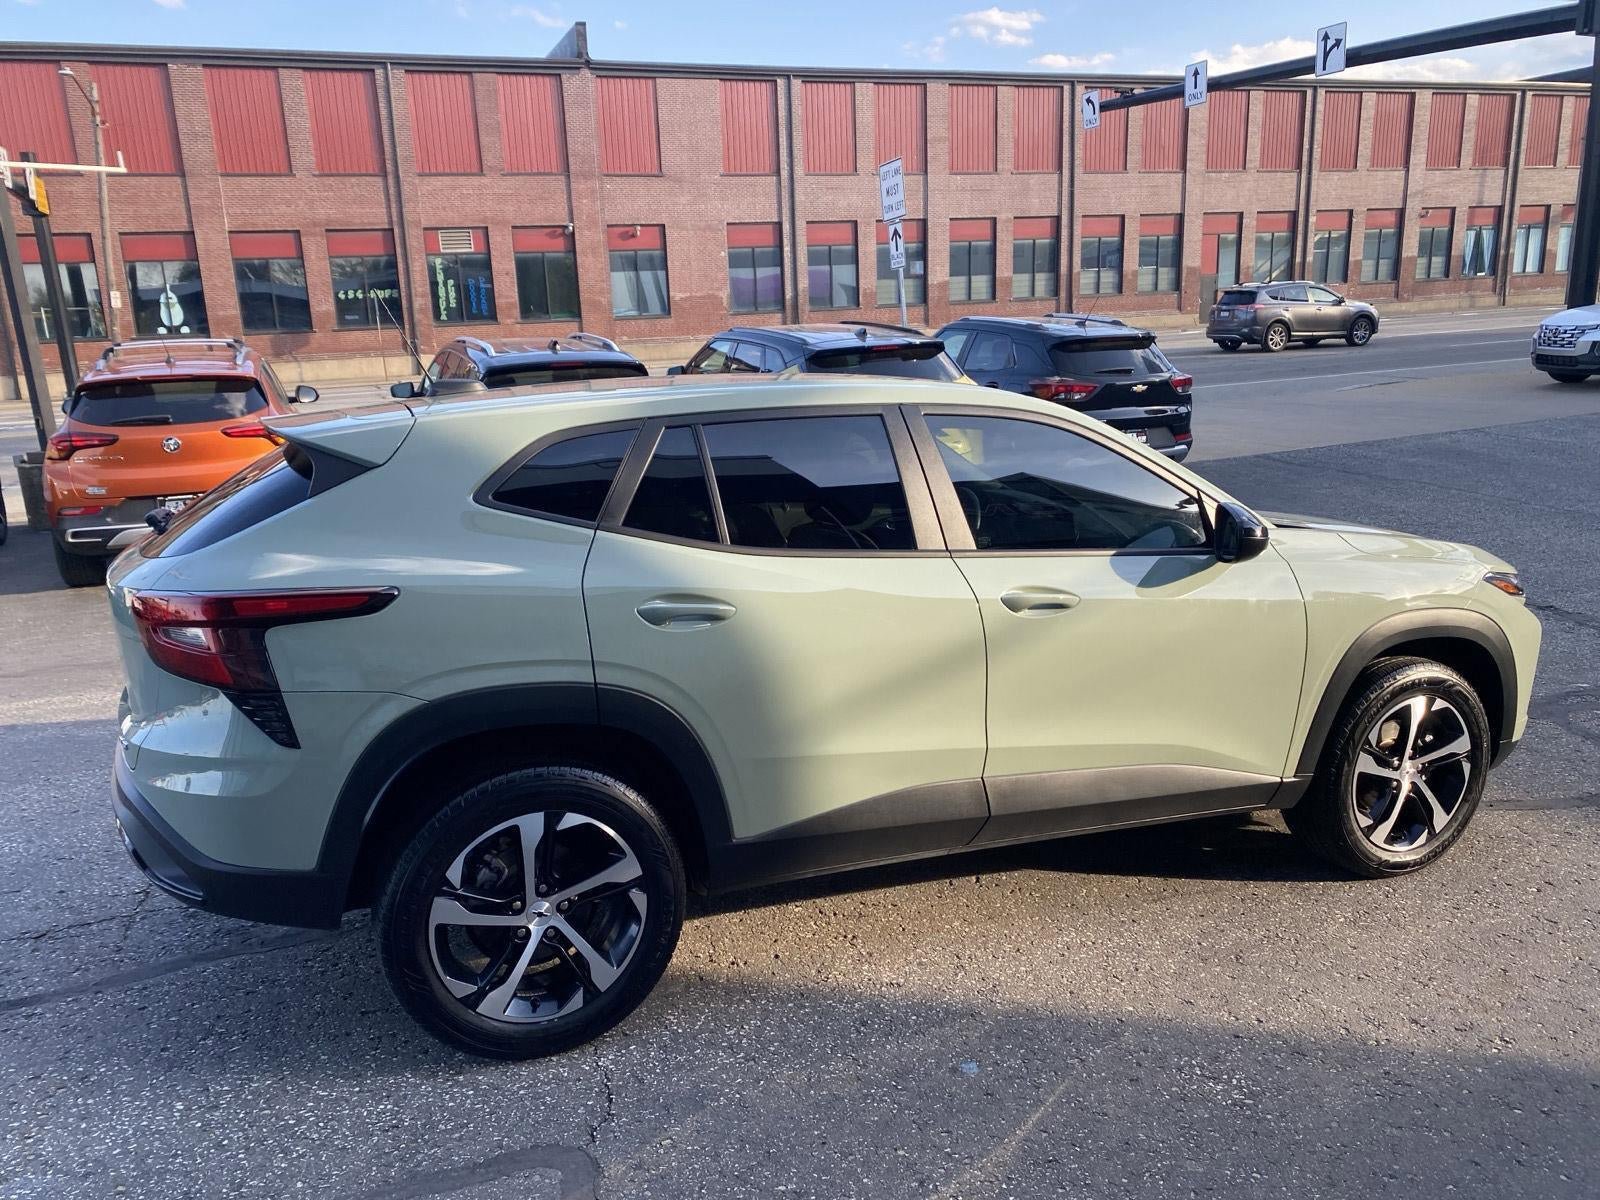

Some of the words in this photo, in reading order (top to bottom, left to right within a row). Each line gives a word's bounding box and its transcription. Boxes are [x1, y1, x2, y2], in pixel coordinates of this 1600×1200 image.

[1188, 90, 1203, 102] ONLY
[1085, 117, 1097, 126] ONLY
[881, 169, 891, 181] LEFT
[891, 166, 901, 177] LANE
[886, 183, 898, 196] MUST
[884, 203, 894, 214] TURN
[894, 199, 904, 212] LEFT
